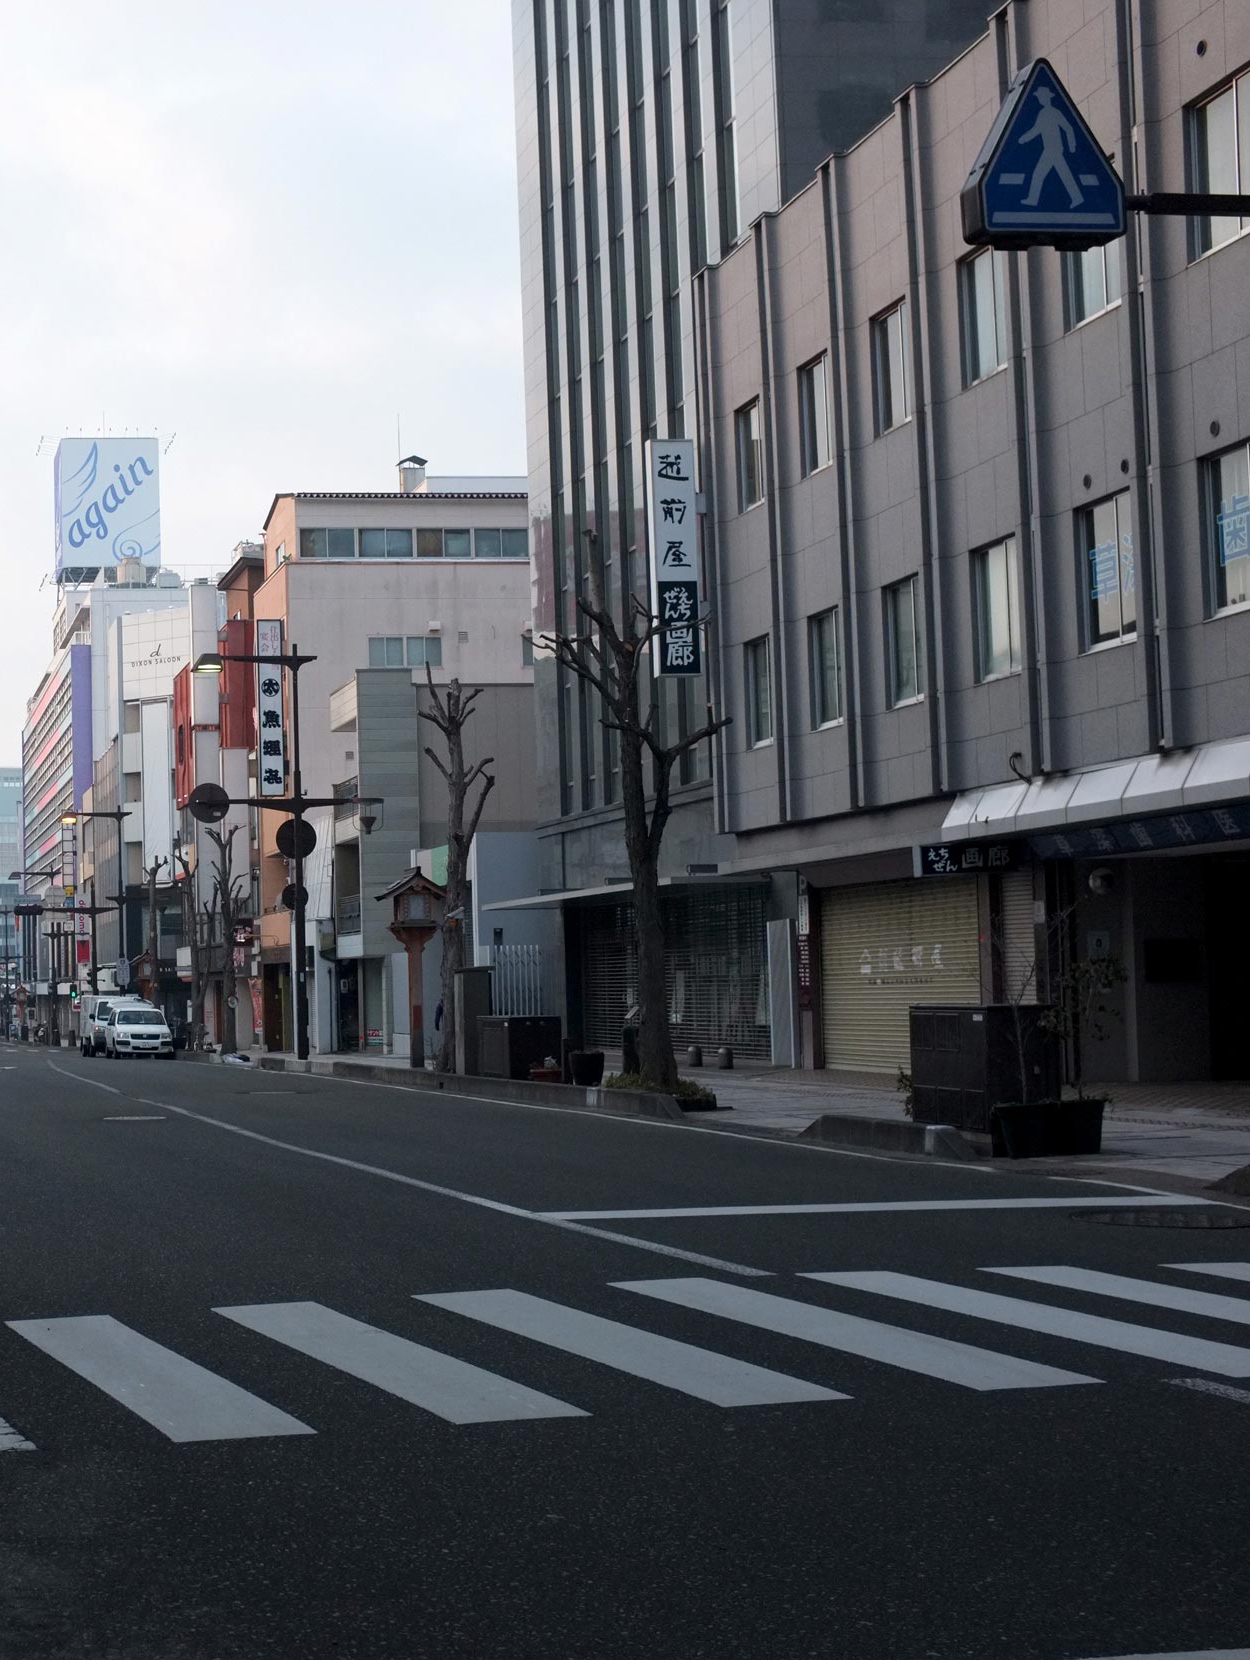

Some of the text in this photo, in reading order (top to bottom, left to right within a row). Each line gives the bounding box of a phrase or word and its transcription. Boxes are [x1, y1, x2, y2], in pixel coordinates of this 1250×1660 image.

[68, 456, 154, 548] again
[657, 454, 691, 567] 越前屋
[662, 588, 678, 620] ぜん
[676, 587, 694, 620] えち
[149, 643, 161, 658] d
[666, 622, 695, 667] 画廊
[131, 656, 181, 668] DIXON SALOON
[928, 848, 949, 861] えち
[933, 860, 958, 872] ぜん
[961, 846, 1010, 869] 画廊
